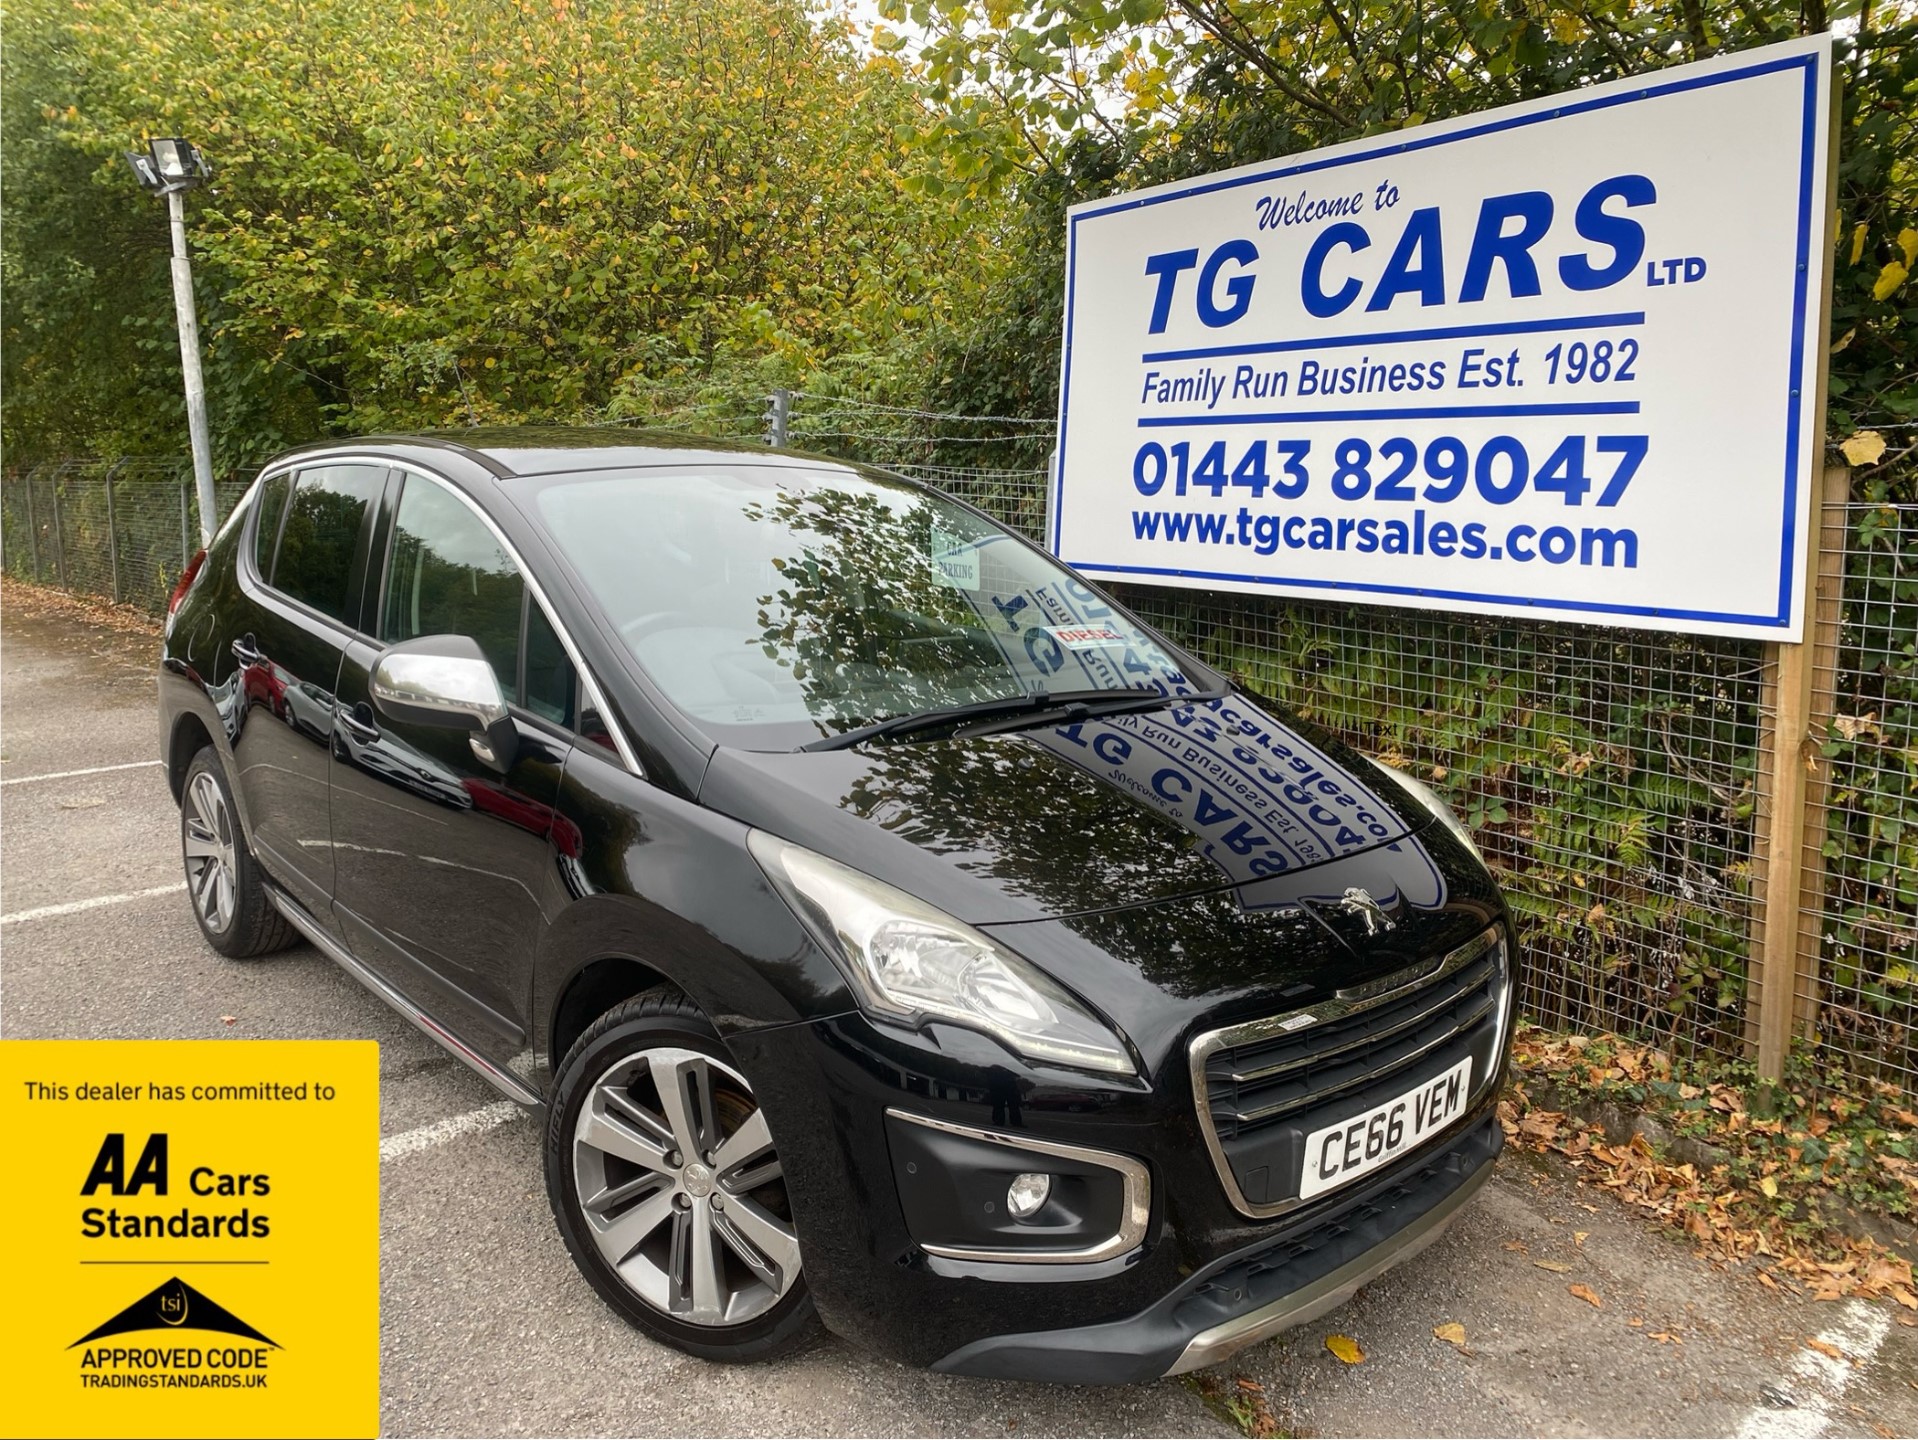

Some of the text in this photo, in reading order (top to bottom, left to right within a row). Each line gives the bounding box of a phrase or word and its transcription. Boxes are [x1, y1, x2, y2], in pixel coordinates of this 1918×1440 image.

[1256, 179, 1400, 231] Welcome to
[1146, 175, 1706, 335] TG CARS LTD
[1142, 338, 1638, 408] Family Run Business Est. 1982
[1133, 435, 1648, 506] 01443 829047
[1132, 507, 1637, 568] www.tgcarsales.com
[1056, 629, 1124, 642] DIESEL
[1318, 1068, 1463, 1181] CE66 VEM
